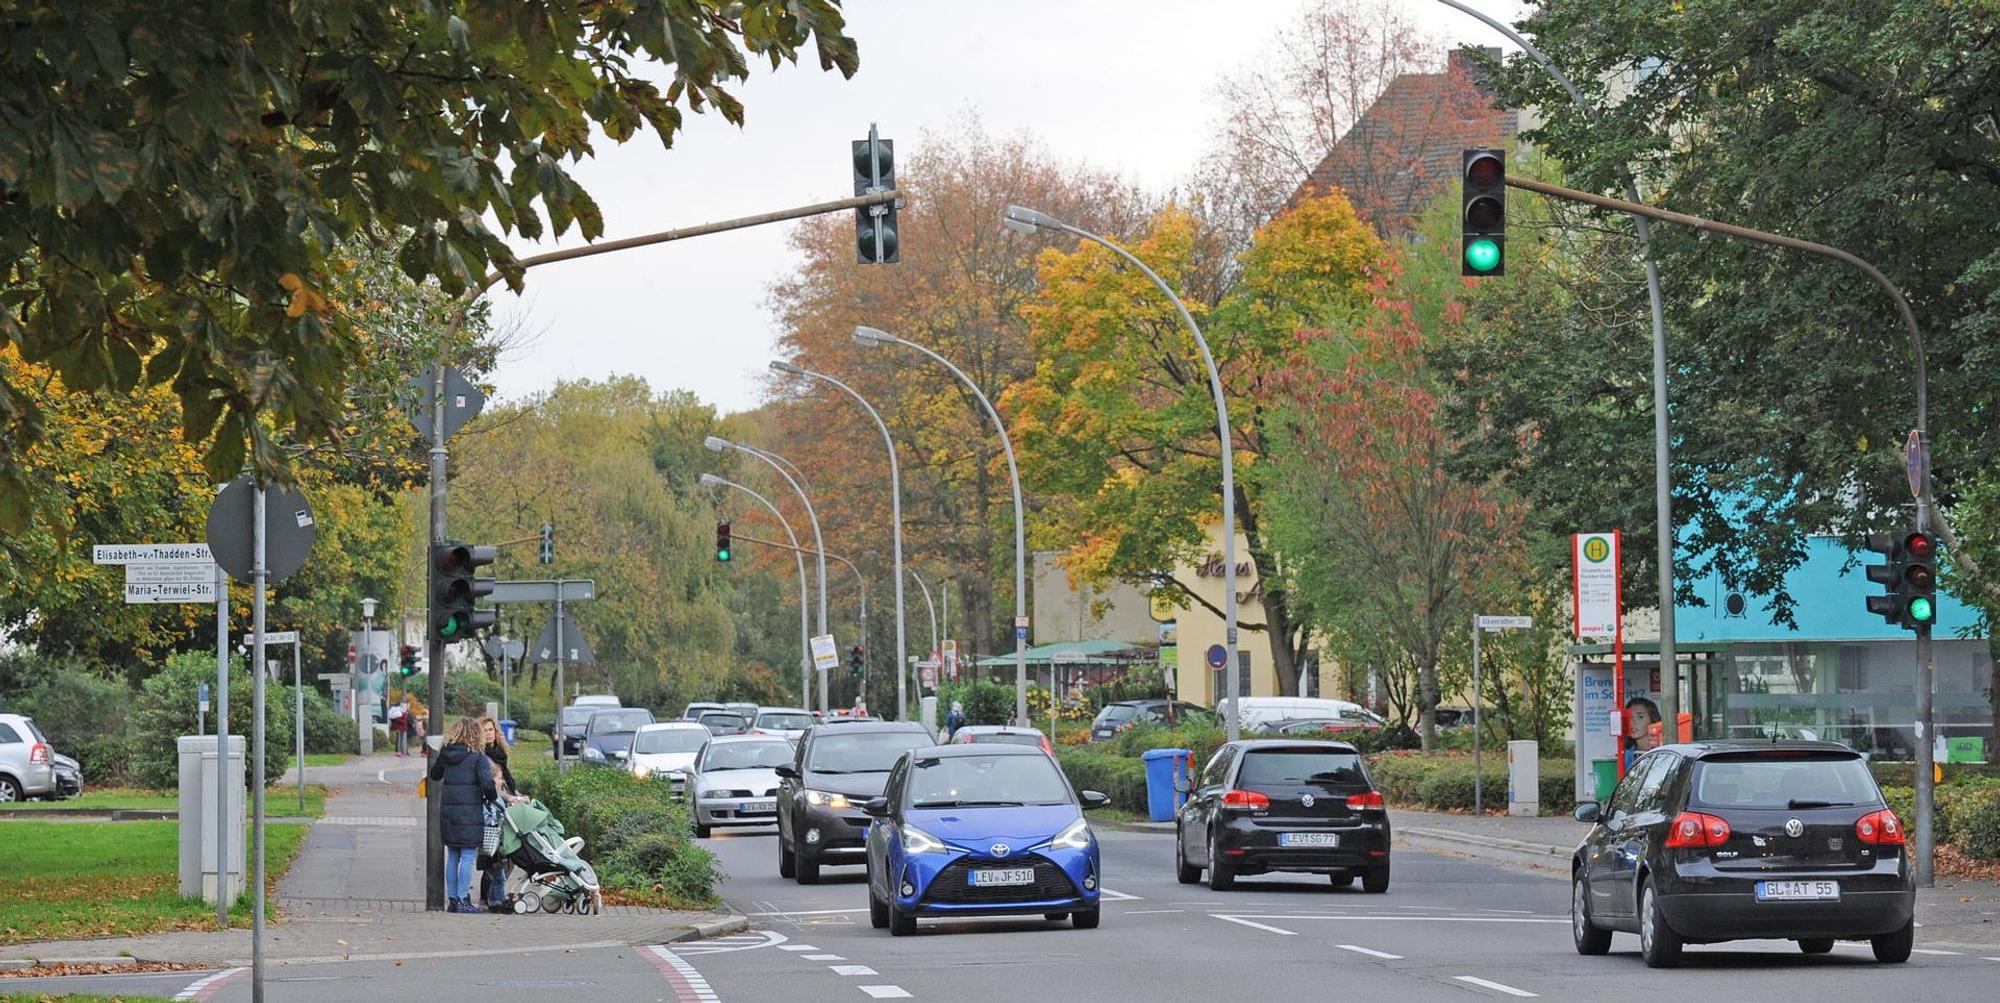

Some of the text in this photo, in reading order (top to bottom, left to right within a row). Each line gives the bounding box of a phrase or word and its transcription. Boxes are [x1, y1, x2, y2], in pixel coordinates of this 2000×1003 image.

[97, 548, 211, 560] Elisabeth-v.-Thadden-Str.
[128, 584, 212, 595] Maria-Terwiel-Str.
[1584, 689, 1599, 700] im
[1287, 834, 1306, 843] LEV
[1310, 835, 1322, 843] SG
[975, 870, 1033, 883] LEV JF 510
[1766, 883, 1832, 895] GL AT 55
